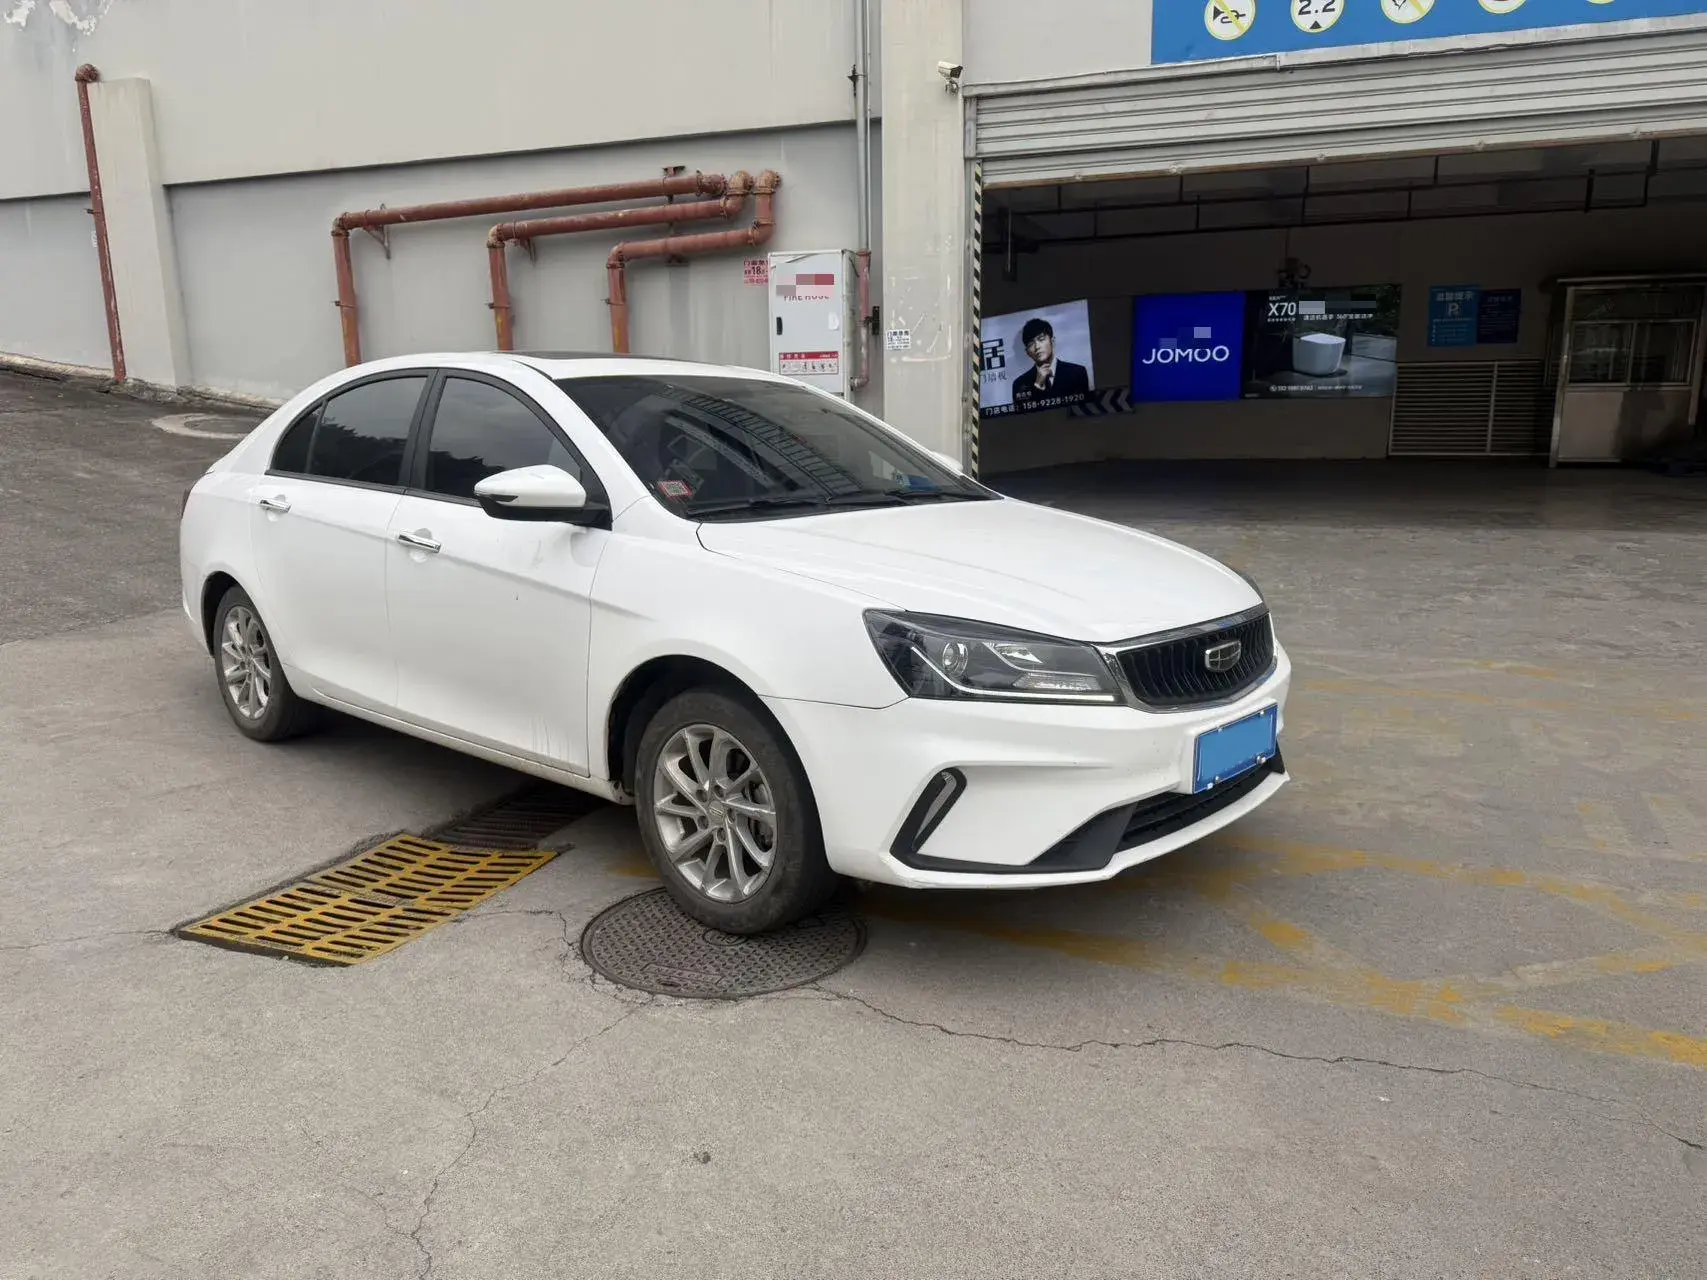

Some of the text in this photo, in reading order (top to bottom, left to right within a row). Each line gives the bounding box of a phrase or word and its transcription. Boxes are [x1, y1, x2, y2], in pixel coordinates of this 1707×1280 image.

[1298, 0, 1335, 15] 2.2
[1267, 302, 1297, 316] X70
[1142, 345, 1230, 365] JOMOO
